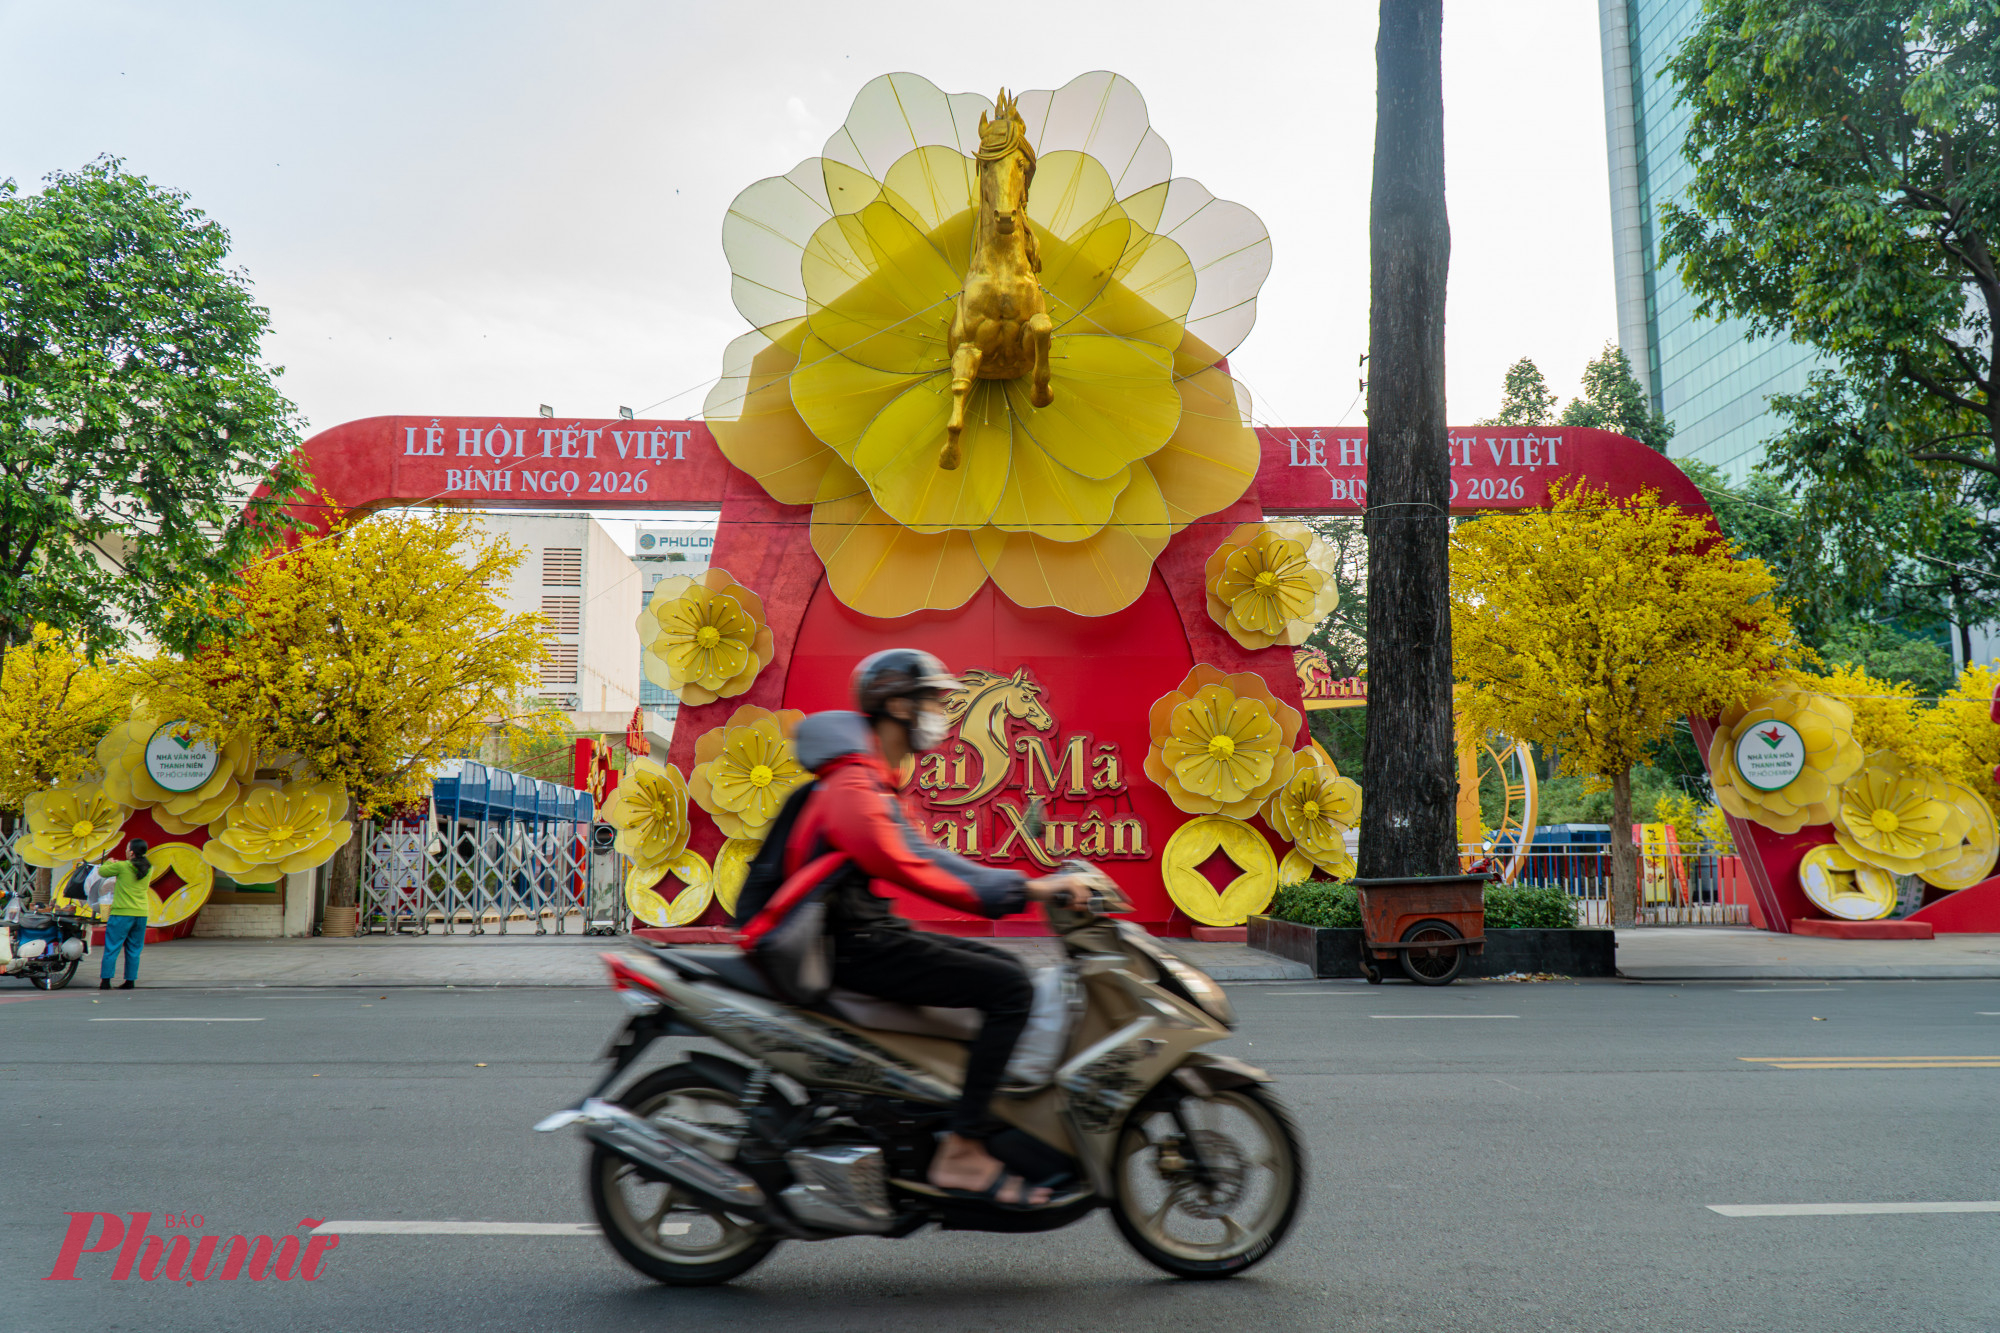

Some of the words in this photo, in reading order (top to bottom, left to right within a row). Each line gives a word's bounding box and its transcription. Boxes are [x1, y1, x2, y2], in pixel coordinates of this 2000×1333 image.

[404, 418, 445, 457] LỄ
[456, 423, 526, 465] HỘI
[536, 422, 603, 459] TẾT
[611, 425, 691, 466] VIỆT
[1288, 429, 1328, 467] LỄ
[1485, 432, 1563, 472] VIỆT
[445, 465, 513, 492] BÍNH
[521, 470, 580, 497] NGỌ
[588, 469, 648, 494] 2026
[1330, 474, 1367, 501] BÍN
[1466, 475, 1525, 501] 2026
[1015, 735, 1122, 795] Mã
[990, 795, 1146, 867] Xuân
[1394, 817, 1410, 828] 24
